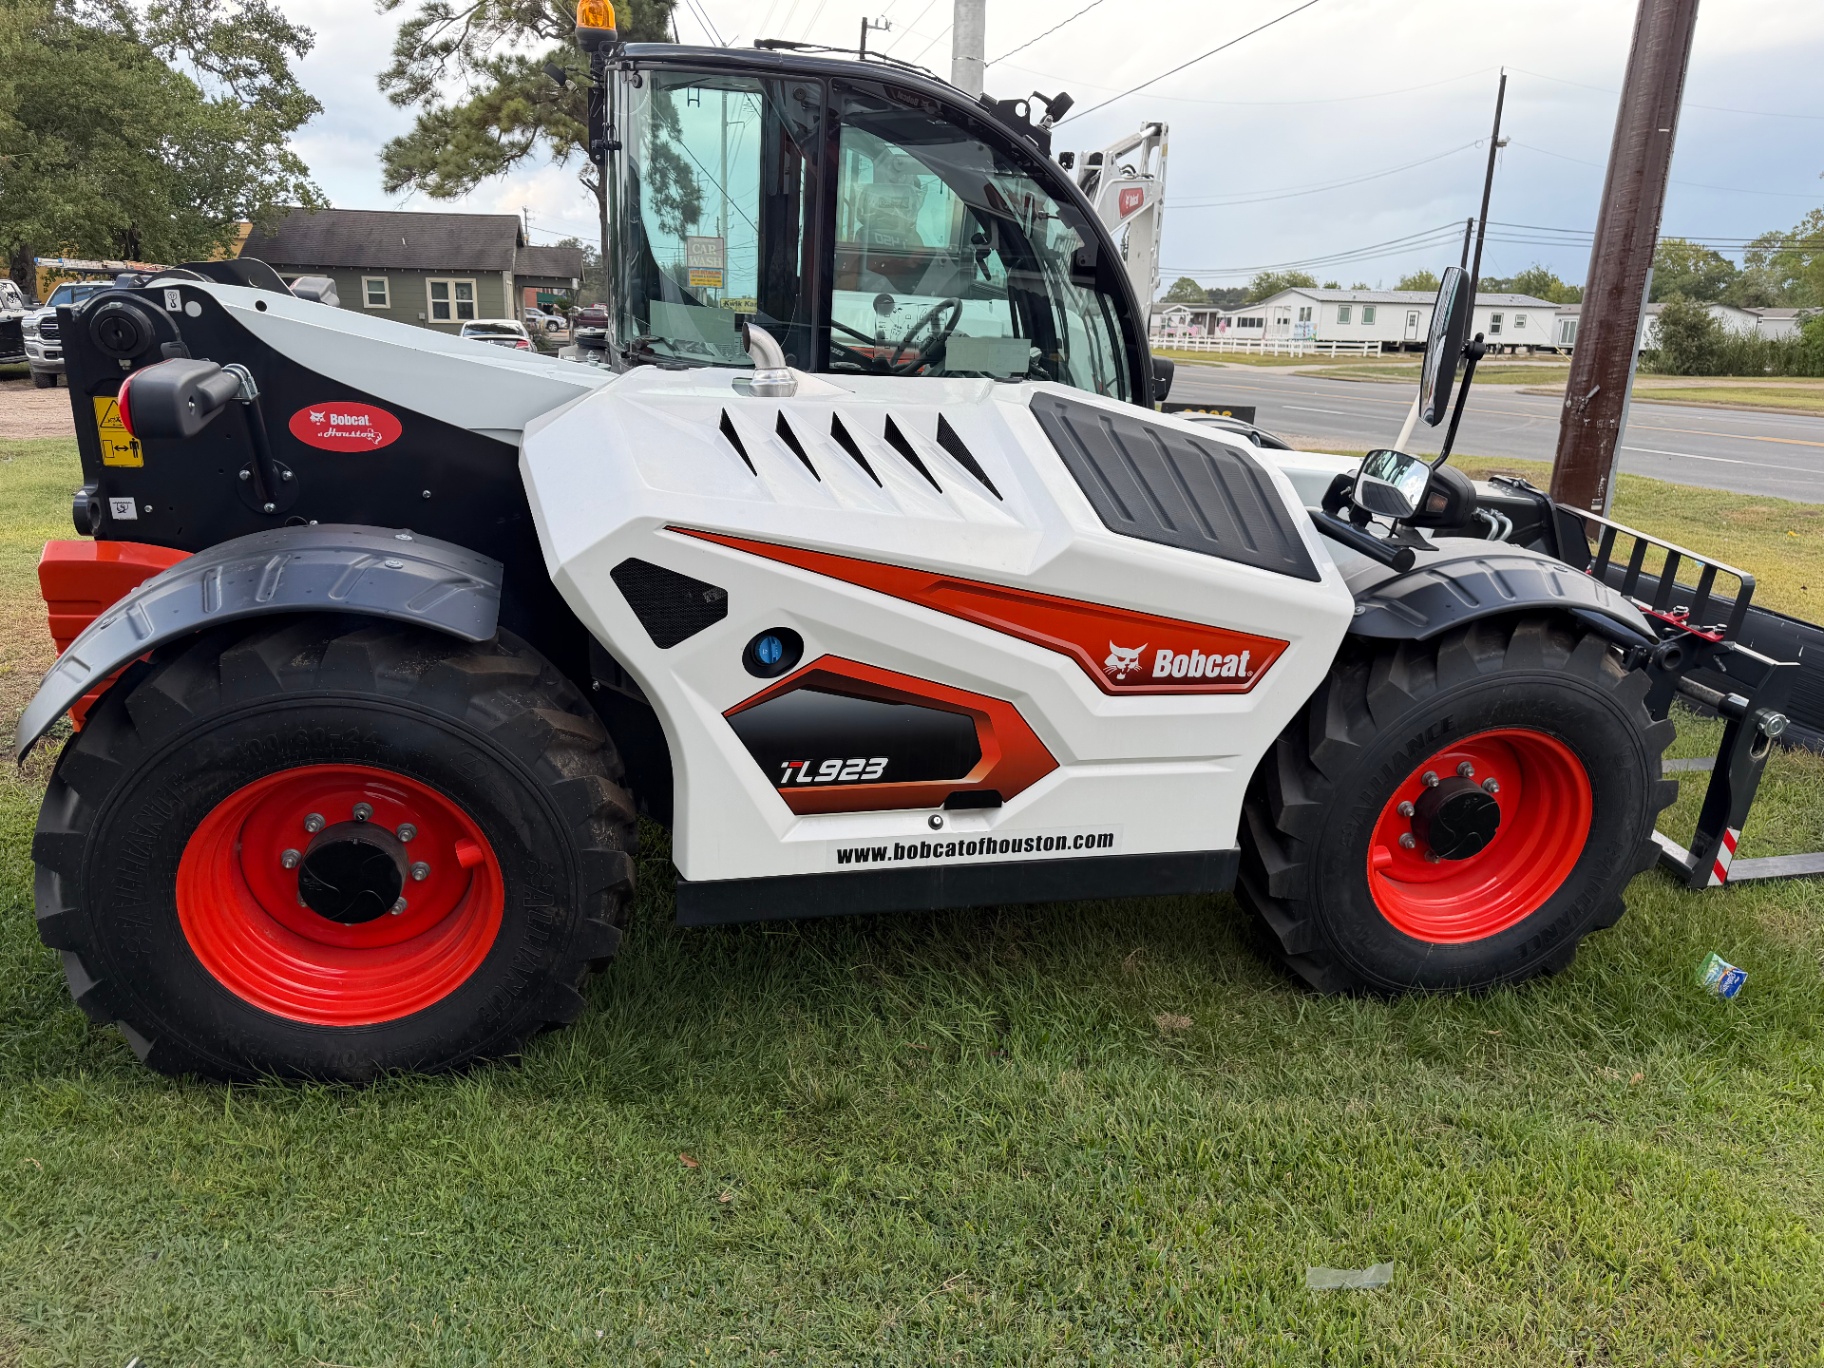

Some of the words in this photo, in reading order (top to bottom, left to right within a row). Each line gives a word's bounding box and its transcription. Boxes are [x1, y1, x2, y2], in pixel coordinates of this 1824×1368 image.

[692, 243, 717, 255] CAR
[688, 255, 722, 267] WASH
[724, 299, 742, 307] Kwik
[330, 413, 370, 426] Bobcat
[323, 427, 376, 438] Houston
[1152, 649, 1251, 678] Bobcat
[112, 773, 185, 928] ALLIANCE
[836, 832, 1115, 865] www.bobcatofhouston.com
[474, 884, 555, 1023] ALLIANCE
